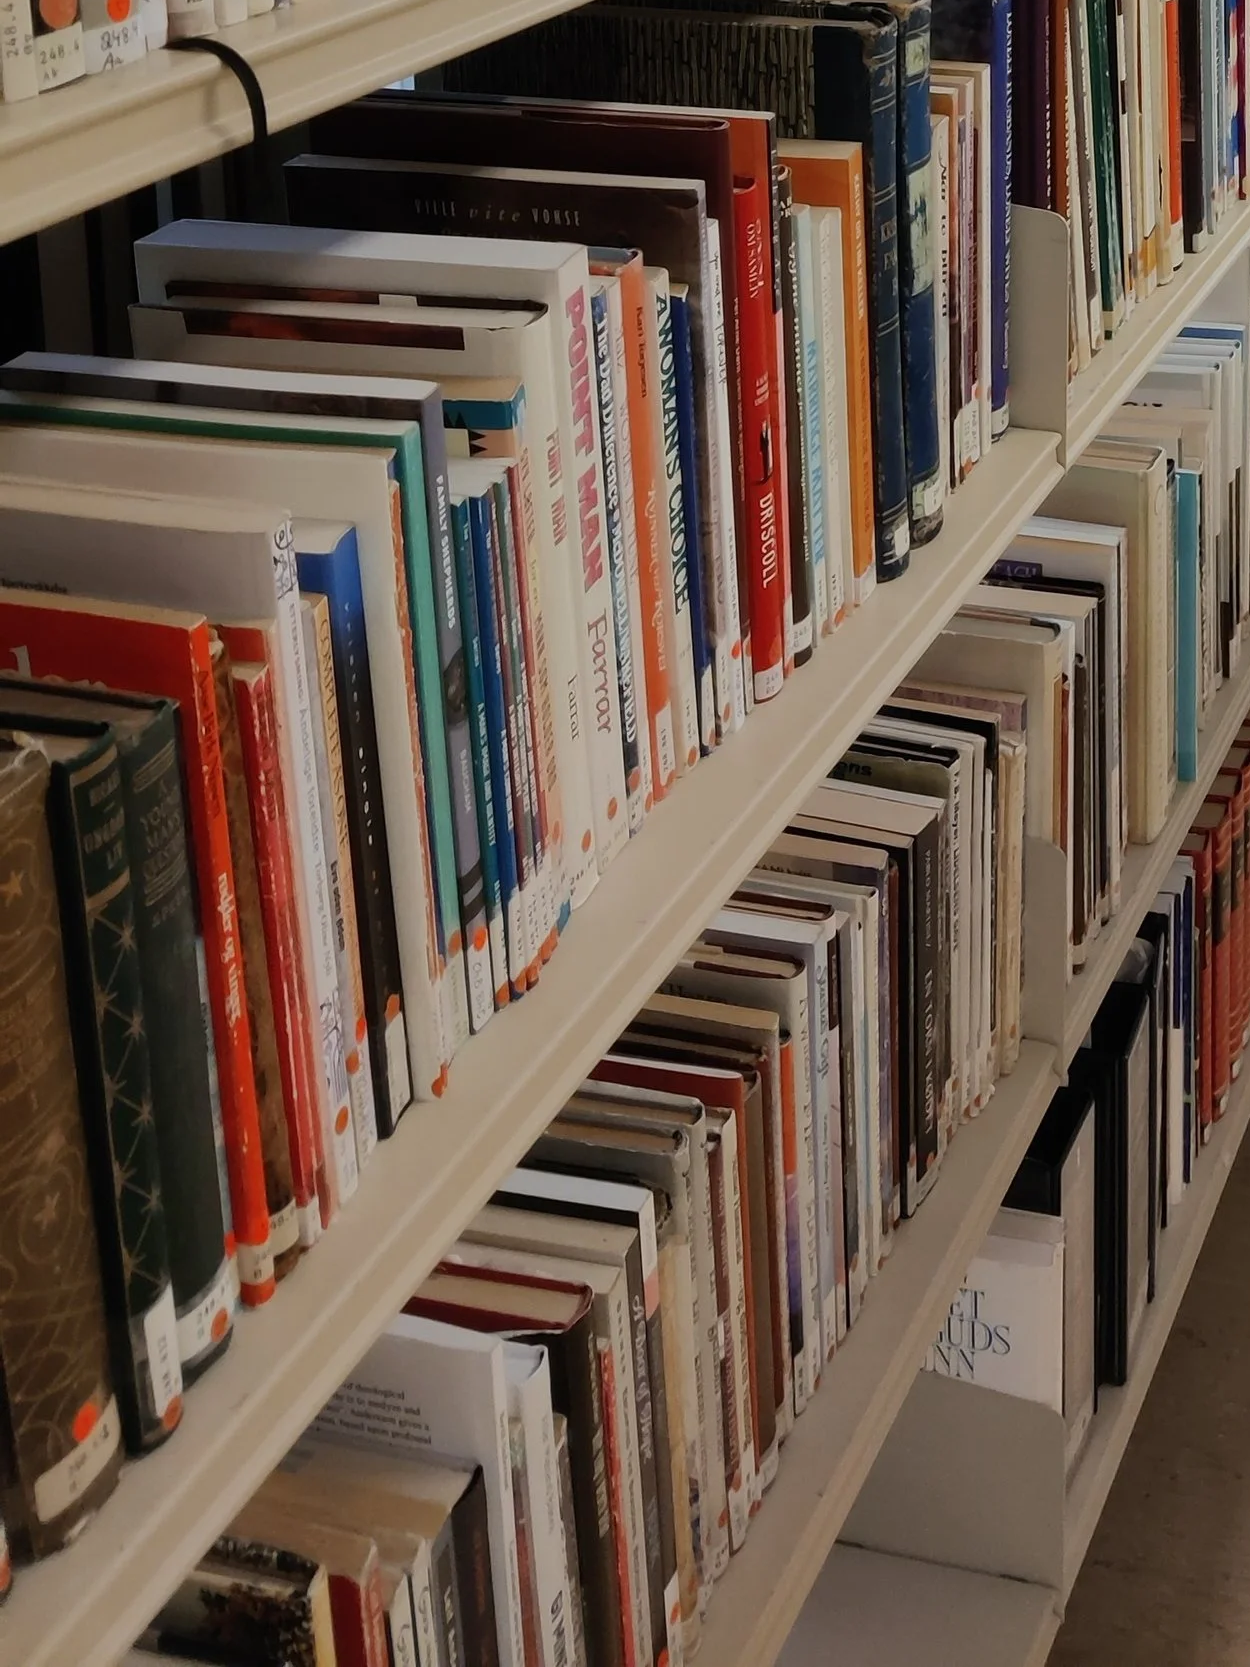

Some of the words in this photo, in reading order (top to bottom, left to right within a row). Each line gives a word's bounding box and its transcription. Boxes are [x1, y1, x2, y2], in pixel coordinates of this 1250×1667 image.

[855, 244, 863, 267] TIM
[857, 269, 865, 320] KELLER
[565, 285, 595, 457] POINT
[595, 314, 610, 359] The
[599, 361, 614, 404] Dad
[807, 340, 821, 454] MARRIAGE
[545, 429, 563, 489] POINT
[603, 406, 621, 509] Difference
[435, 475, 448, 531] FAMILY
[551, 494, 568, 547] MAN
[577, 464, 604, 594] MAN
[758, 492, 777, 589] DRISCOLL
[440, 537, 456, 629] SHEPHERDS
[668, 485, 690, 616] CHOICE
[319, 619, 343, 761] COMPLETE
[566, 674, 582, 742] Farrar
[587, 609, 614, 734] Farrar
[298, 707, 314, 783] Åndelige
[306, 786, 321, 853] foreldre
[220, 937, 235, 964] og
[937, 1316, 1011, 1356] UDS
